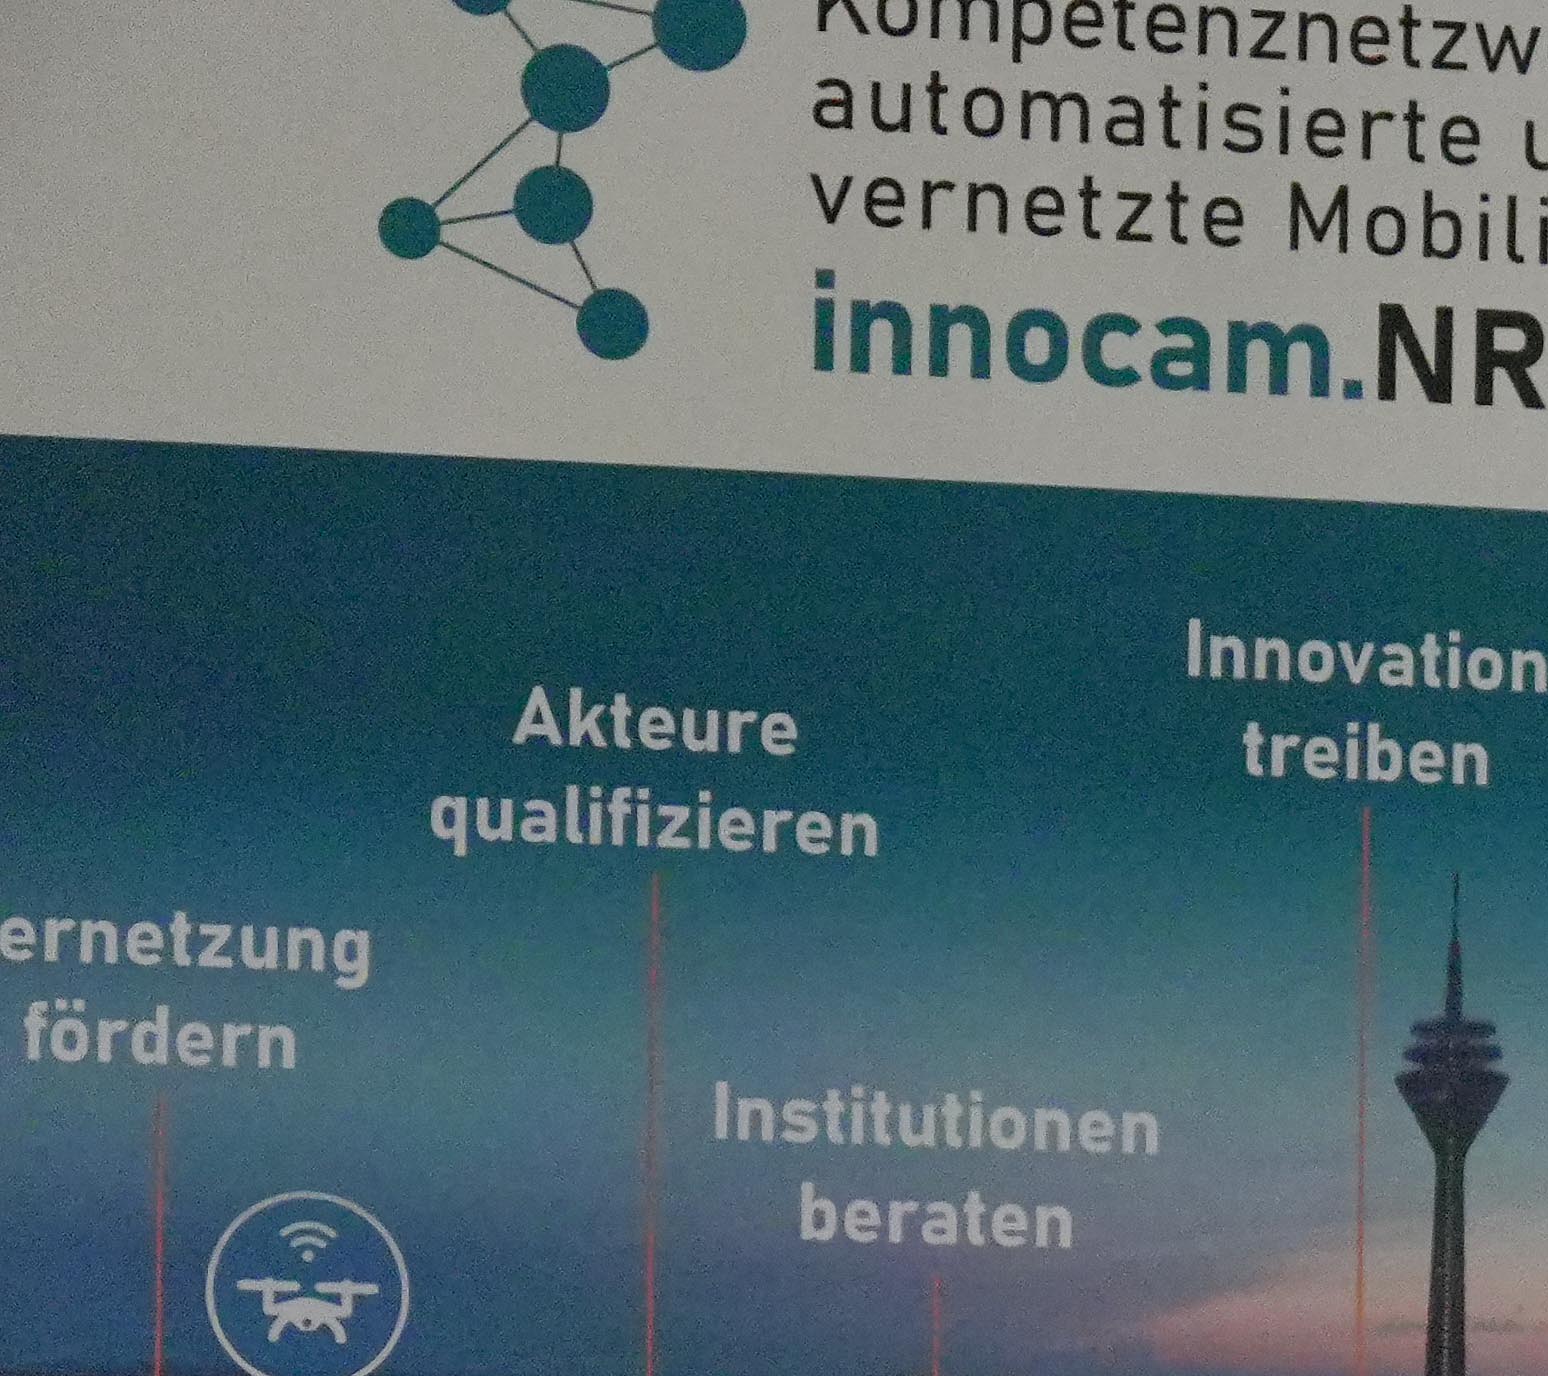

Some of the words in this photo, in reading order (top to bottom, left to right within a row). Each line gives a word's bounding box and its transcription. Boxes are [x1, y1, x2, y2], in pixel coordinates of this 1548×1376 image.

[813, 71, 1480, 166] automatisierte
[811, 174, 1244, 247] vernetzte
[1188, 618, 1547, 693] Innovation
[513, 686, 798, 756] Akteure
[1243, 722, 1488, 785] treiben
[431, 785, 877, 856] qualifizieren
[24, 999, 295, 1069] fördern
[715, 1081, 1159, 1155] Institutionen
[801, 1182, 1072, 1248] beraten
